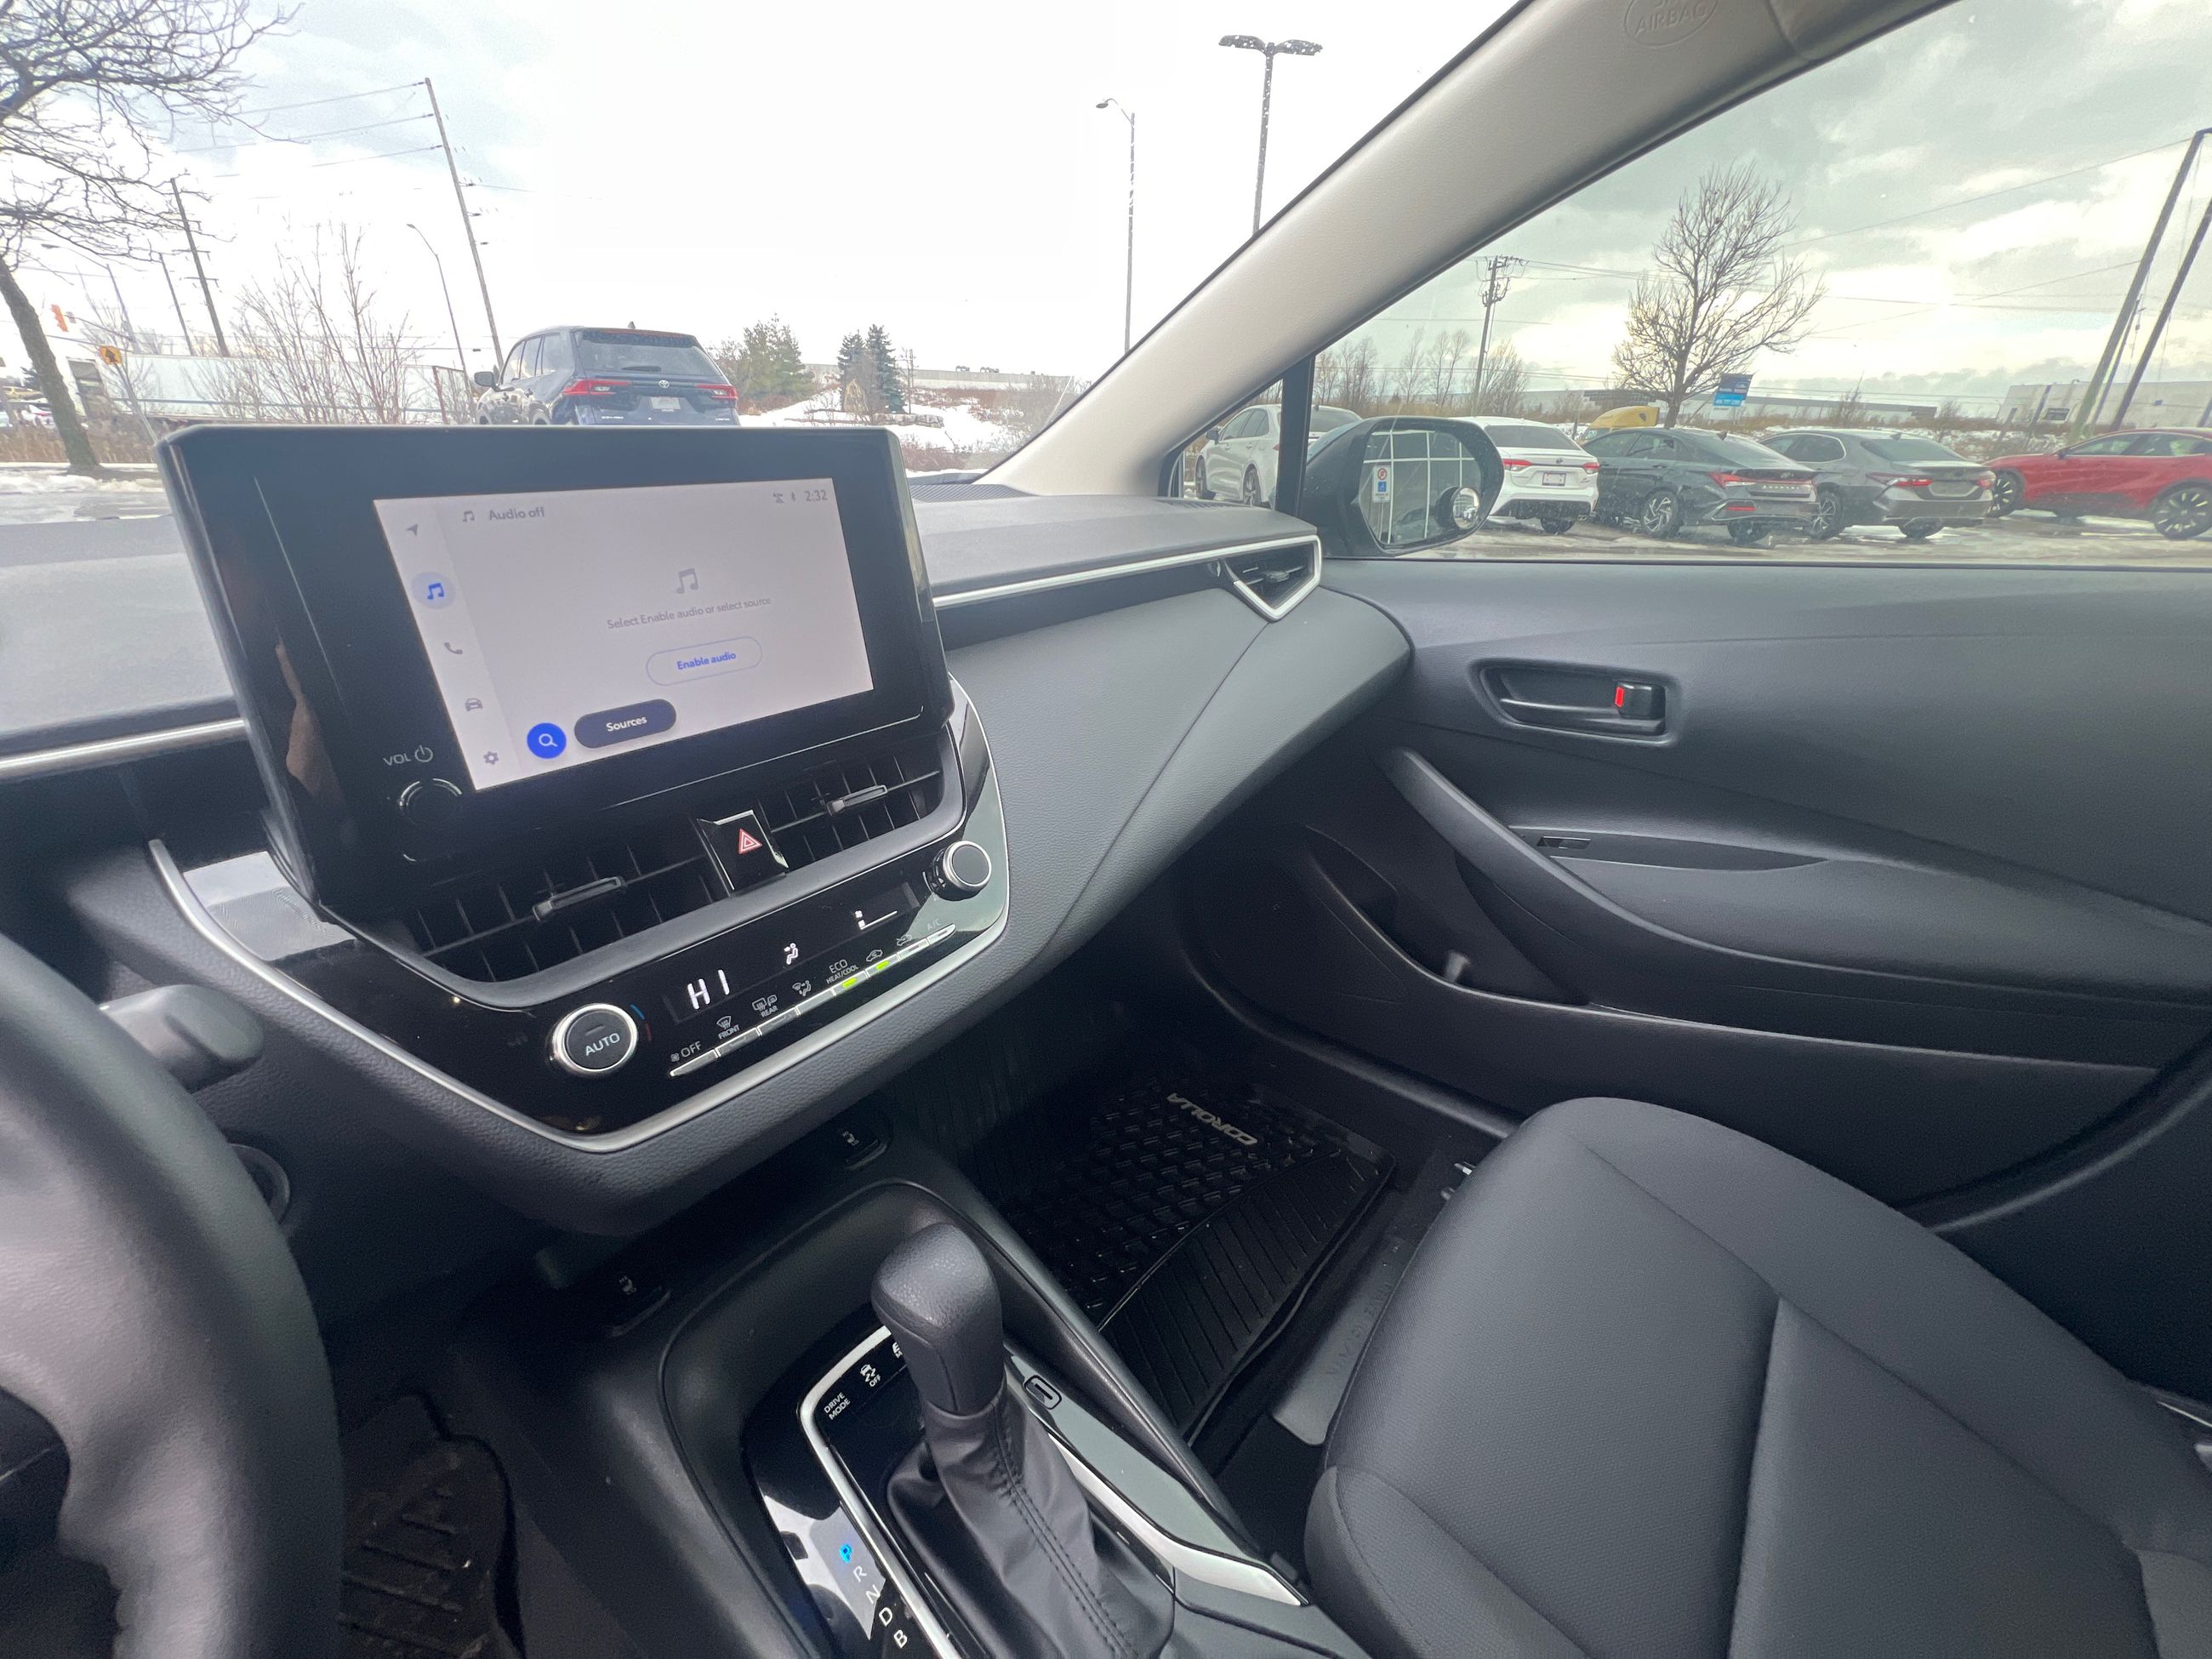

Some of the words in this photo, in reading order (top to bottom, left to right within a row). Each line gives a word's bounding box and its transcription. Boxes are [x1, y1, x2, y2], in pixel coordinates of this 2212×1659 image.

[1634, 3, 1707, 37] AIRBAG
[804, 489, 828, 502] 2:32
[488, 508, 524, 522] Audio
[527, 506, 545, 519] off
[607, 617, 640, 629] Select
[641, 612, 676, 624] Enable
[676, 607, 704, 619] audio
[705, 605, 716, 614] or
[716, 601, 743, 613] select
[744, 597, 772, 608] source
[676, 658, 709, 670] Enable
[710, 652, 737, 664] audio
[606, 715, 647, 733] Sources
[383, 753, 412, 766] VOL
[927, 918, 941, 931] A/C
[825, 964, 859, 983] HEAT/COOL
[829, 959, 848, 974] ECO
[687, 969, 730, 1010] HI
[761, 1005, 778, 1017] REAR
[718, 1023, 740, 1040] FRONT
[584, 1033, 620, 1056] AUTO
[681, 1041, 703, 1058] OFF
[1166, 1092, 1258, 1145] COROLLA
[869, 1375, 881, 1388] OFF
[824, 1392, 846, 1414] DRIVE
[829, 1398, 851, 1420] MODE
[839, 1543, 852, 1563] P
[853, 1565, 867, 1582] R
[865, 1584, 881, 1605] N
[879, 1607, 893, 1627] D
[893, 1629, 908, 1649] B
